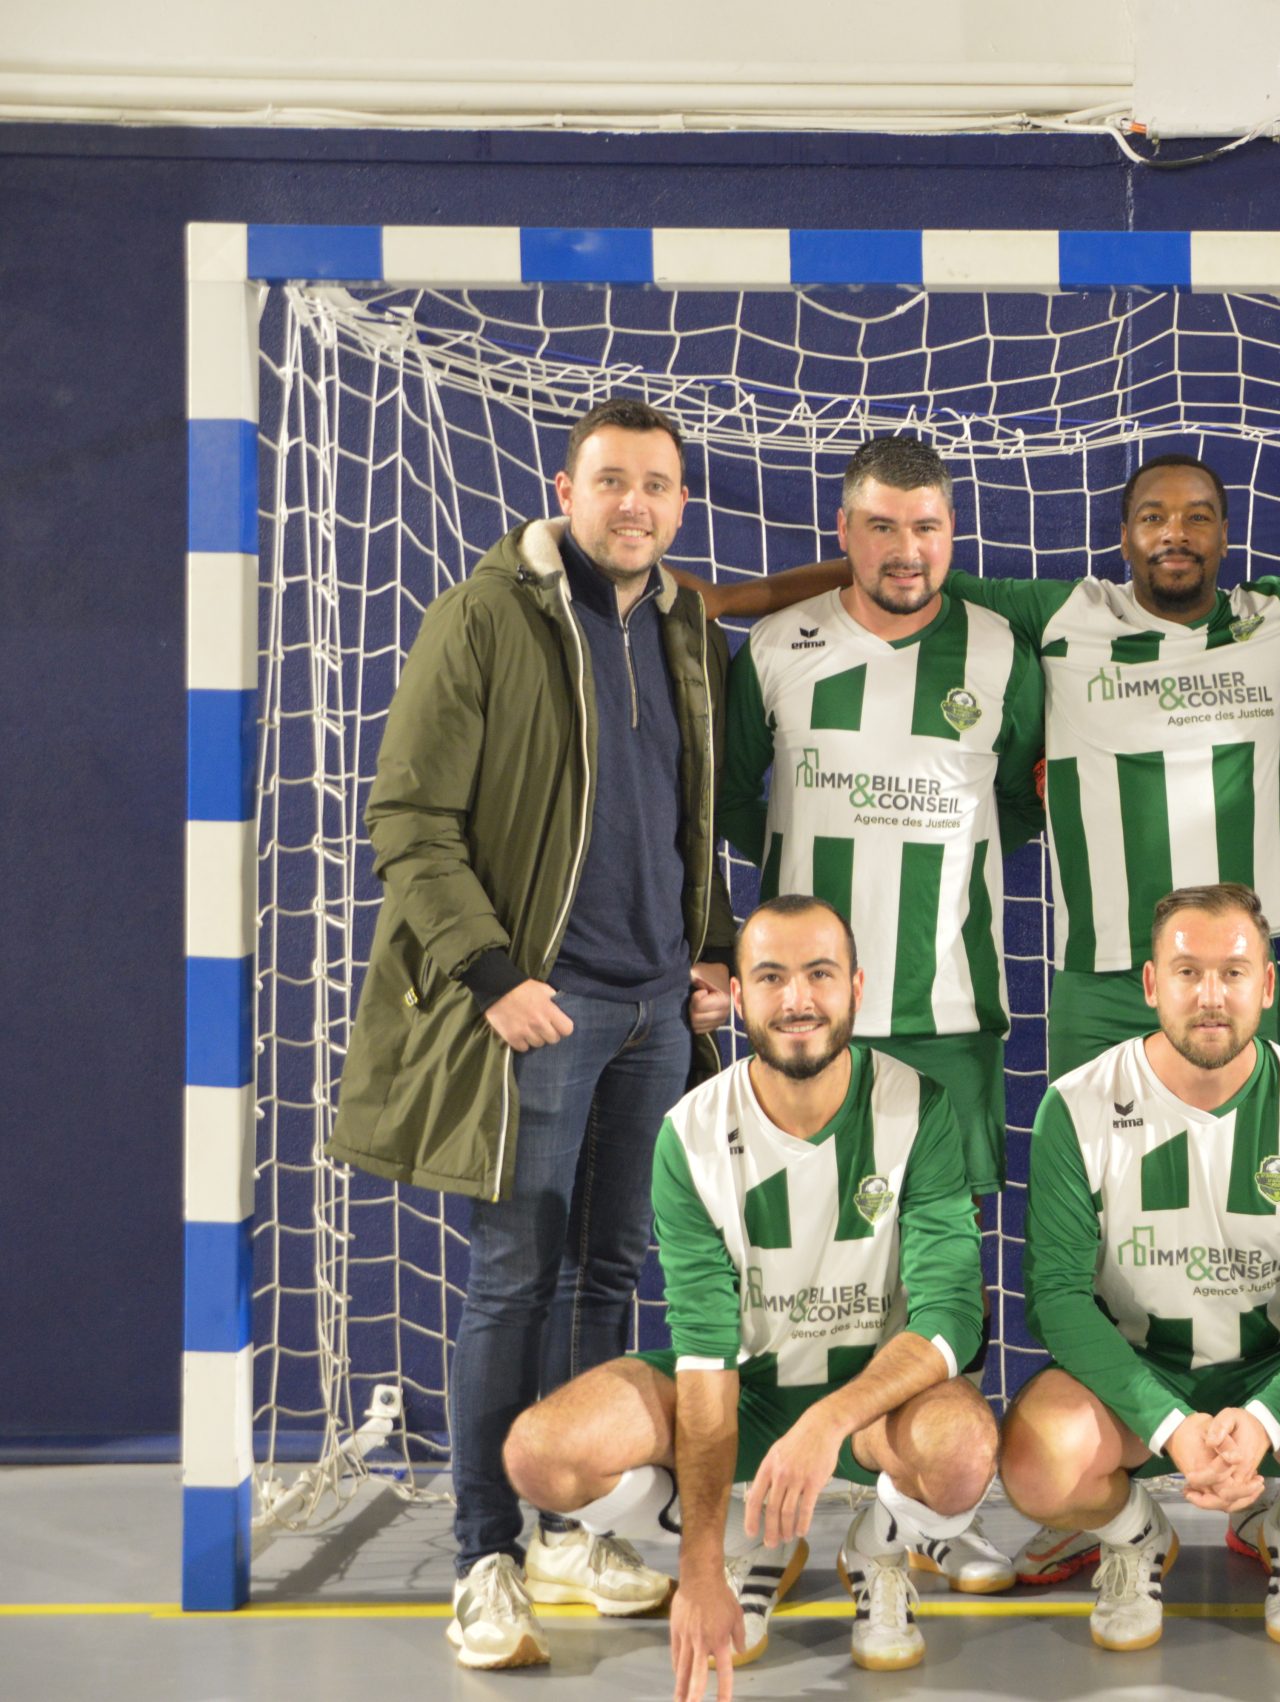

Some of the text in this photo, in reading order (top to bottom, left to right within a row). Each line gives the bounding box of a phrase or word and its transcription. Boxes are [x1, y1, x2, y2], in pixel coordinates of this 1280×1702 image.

[791, 638, 826, 650] erima
[1168, 708, 1274, 726] Agence des Justices
[854, 814, 960, 829] Agence des Justices
[1193, 1286, 1238, 1296] Agence
[830, 1322, 850, 1335] des
